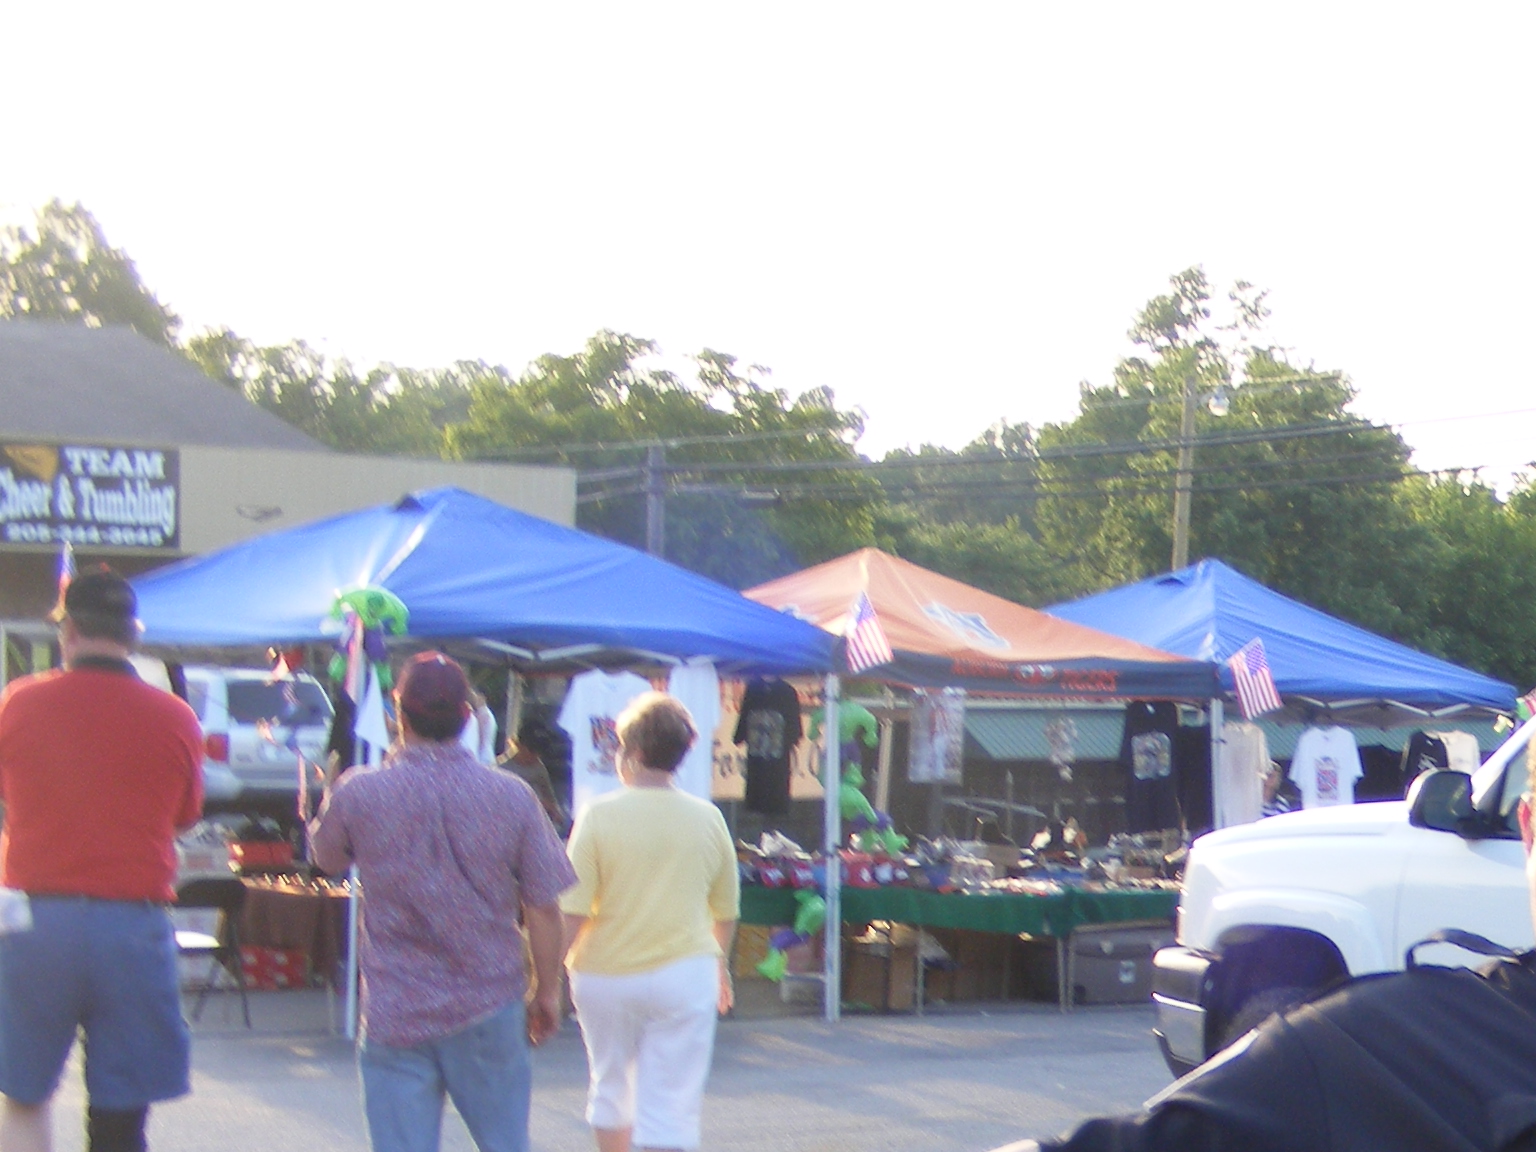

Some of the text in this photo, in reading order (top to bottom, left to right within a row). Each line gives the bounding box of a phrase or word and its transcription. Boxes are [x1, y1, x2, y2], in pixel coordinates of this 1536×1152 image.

[64, 447, 166, 480] TEAM
[58, 473, 76, 520] &
[77, 476, 176, 539] Tumbling
